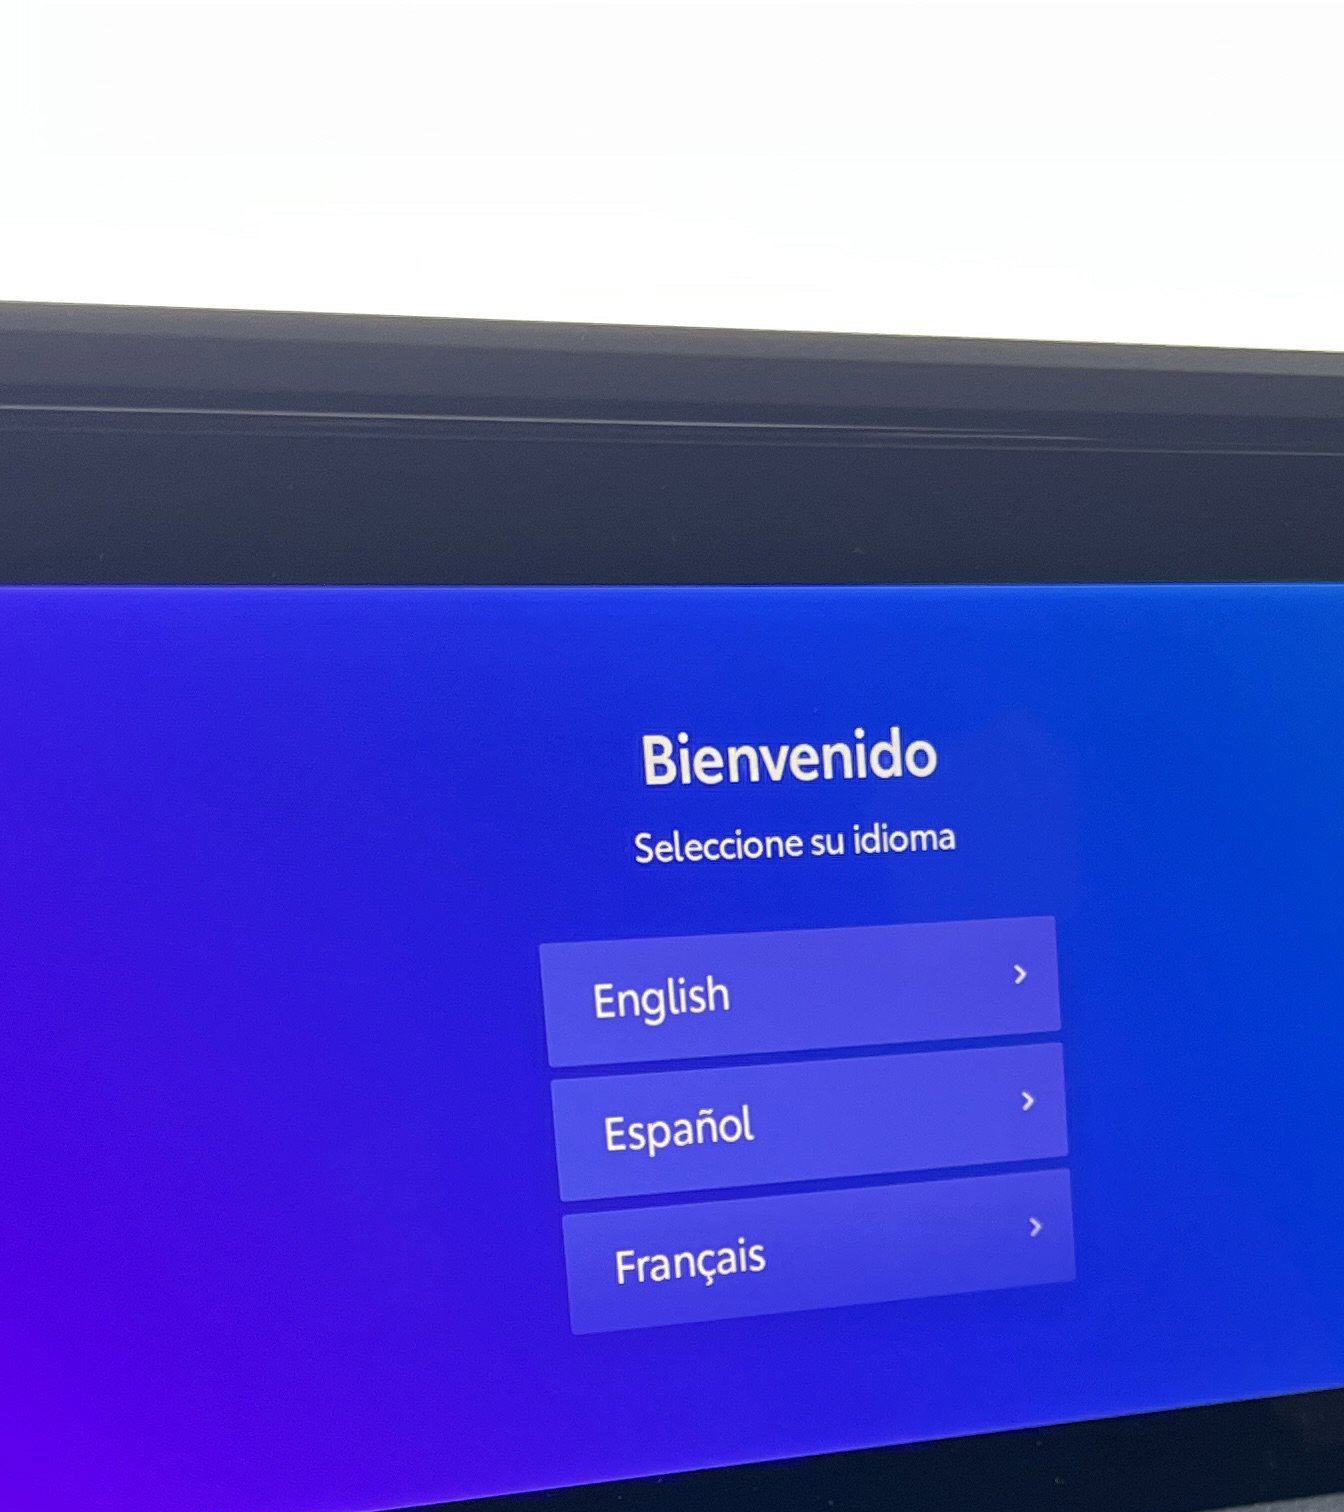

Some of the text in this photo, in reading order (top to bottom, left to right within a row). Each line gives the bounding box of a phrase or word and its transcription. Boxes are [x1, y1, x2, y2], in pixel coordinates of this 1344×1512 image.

[641, 726, 938, 787] Bienvenido
[634, 822, 956, 864] Seleccione su idioma
[593, 975, 731, 1027] English
[603, 1104, 755, 1158] Español
[614, 1236, 767, 1287] Français
